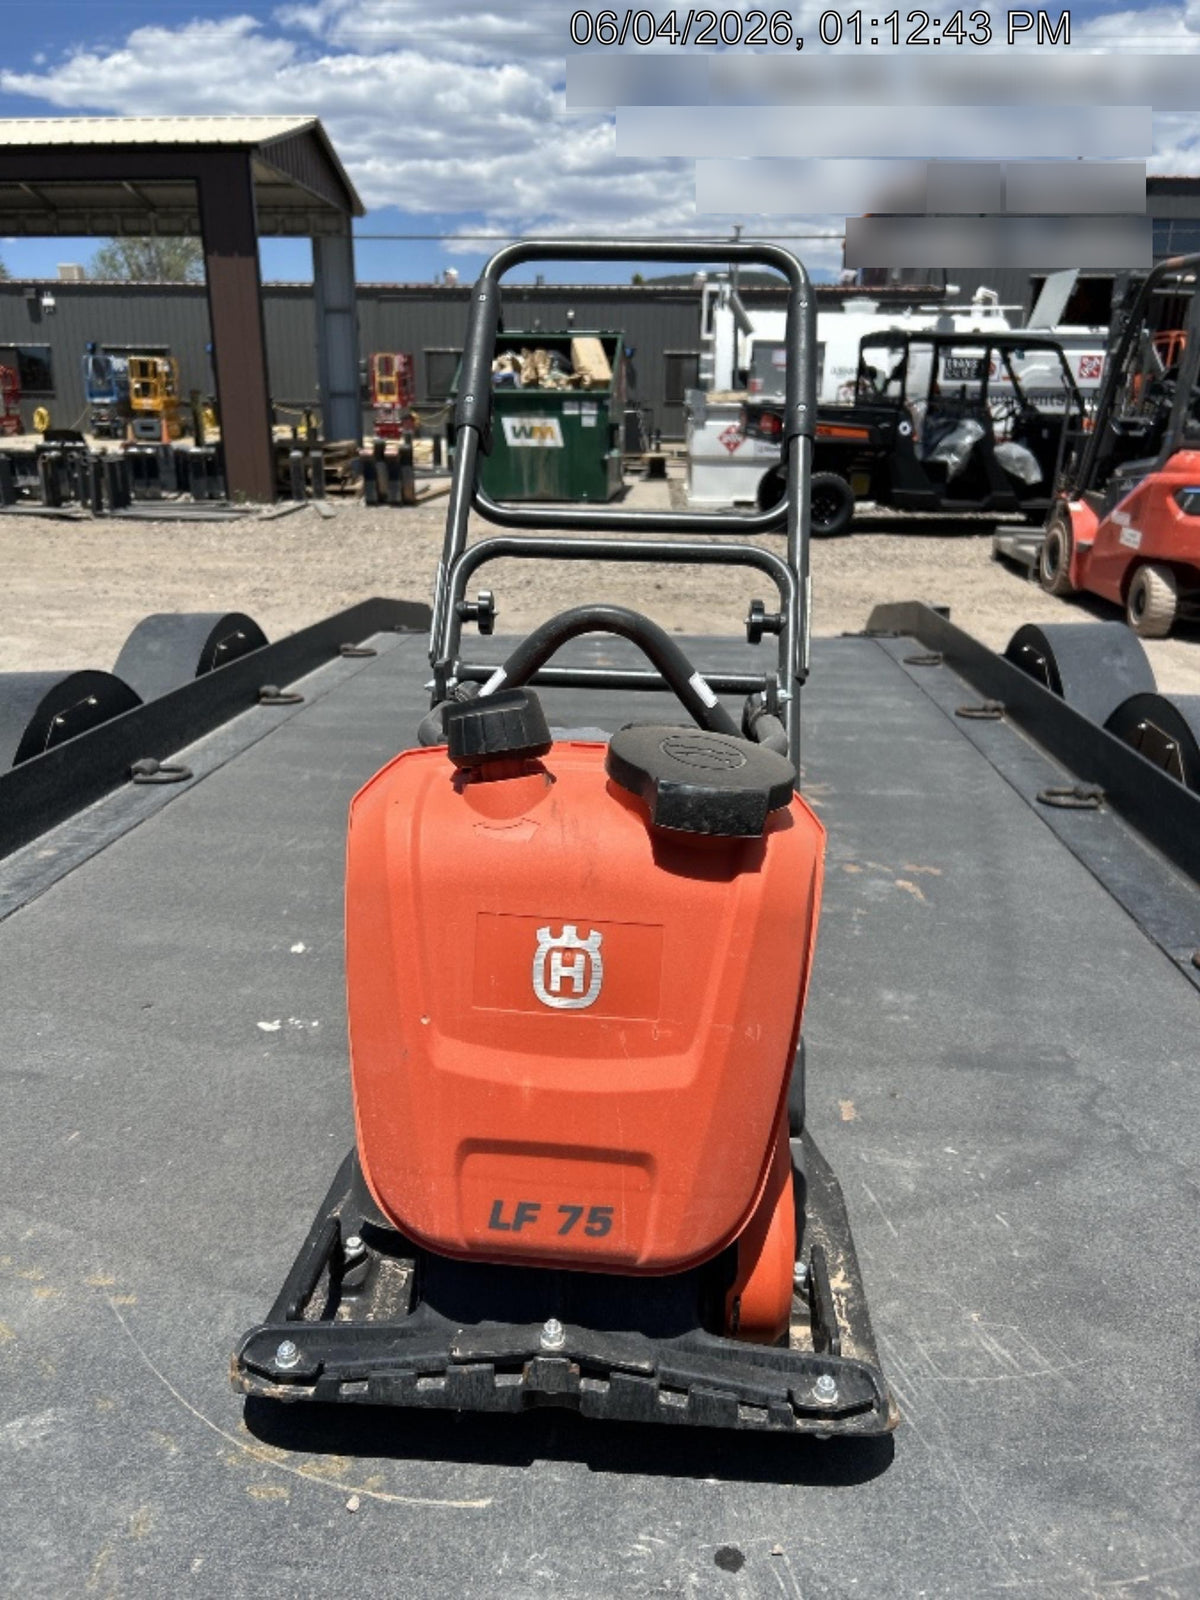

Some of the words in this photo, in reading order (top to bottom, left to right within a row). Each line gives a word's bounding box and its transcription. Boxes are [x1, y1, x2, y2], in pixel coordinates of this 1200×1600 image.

[511, 425, 555, 440] WM
[550, 951, 585, 993] H
[488, 1200, 541, 1232] LF
[557, 1205, 614, 1237] 75
